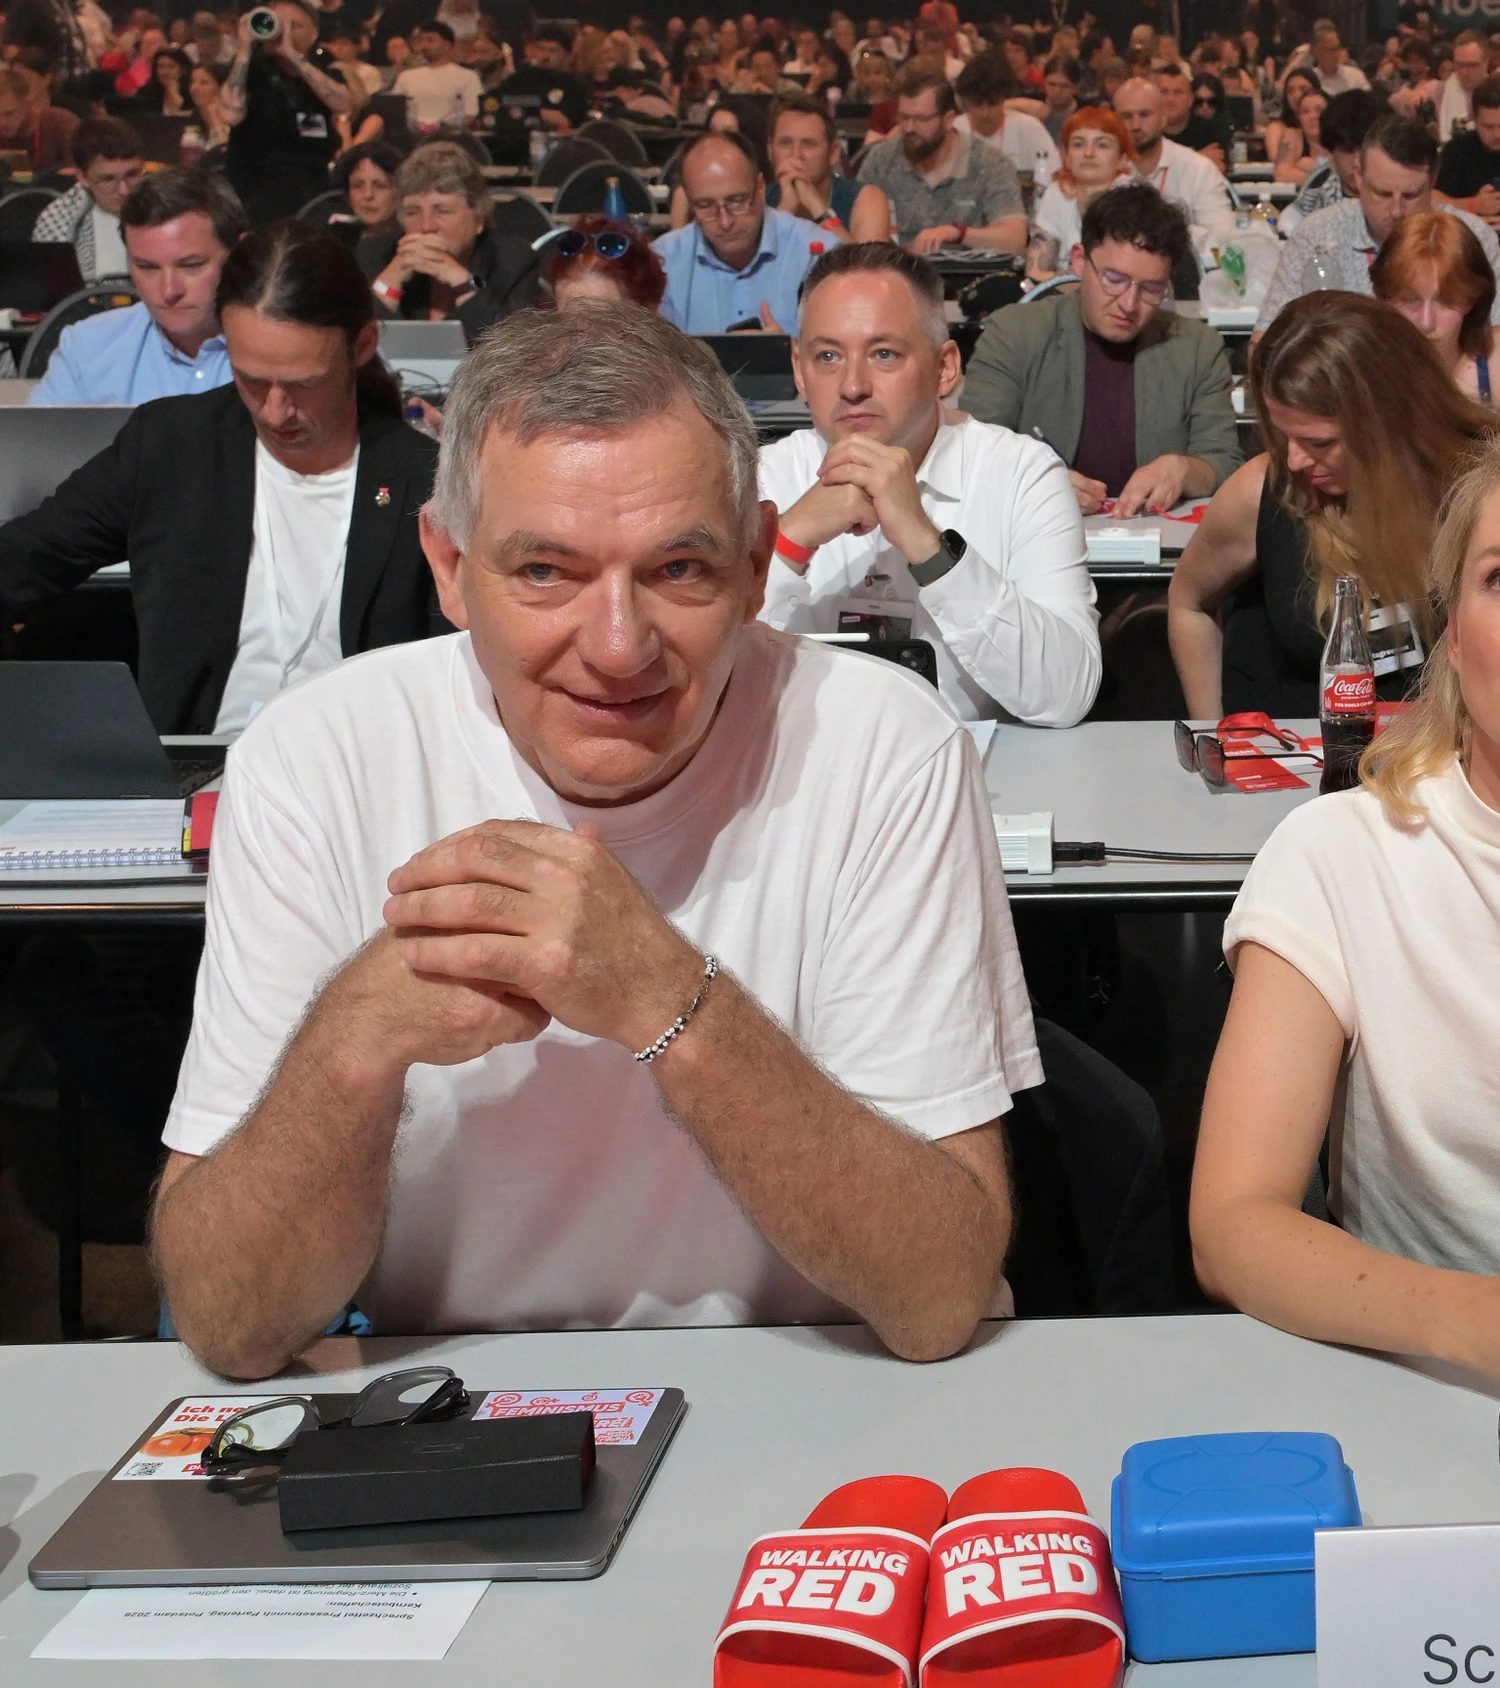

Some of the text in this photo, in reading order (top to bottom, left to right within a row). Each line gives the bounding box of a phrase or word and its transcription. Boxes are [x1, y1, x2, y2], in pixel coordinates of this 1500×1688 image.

[1334, 678, 1373, 696] Coca-Cola
[182, 1404, 255, 1414] Ich no
[494, 1402, 623, 1417] FEMINISMUS
[173, 1414, 228, 1422] Die L
[940, 1533, 1094, 1570] WALKING
[758, 1549, 911, 1577] WALKING
[943, 1552, 1099, 1619] RED
[302, 1589, 387, 1597] Merz-Regierung
[736, 1568, 896, 1617] RED
[326, 1601, 422, 1609] Kernbotschaften:
[263, 1610, 342, 1618] Pressebrunch
[344, 1611, 415, 1620] Sprechzettel
